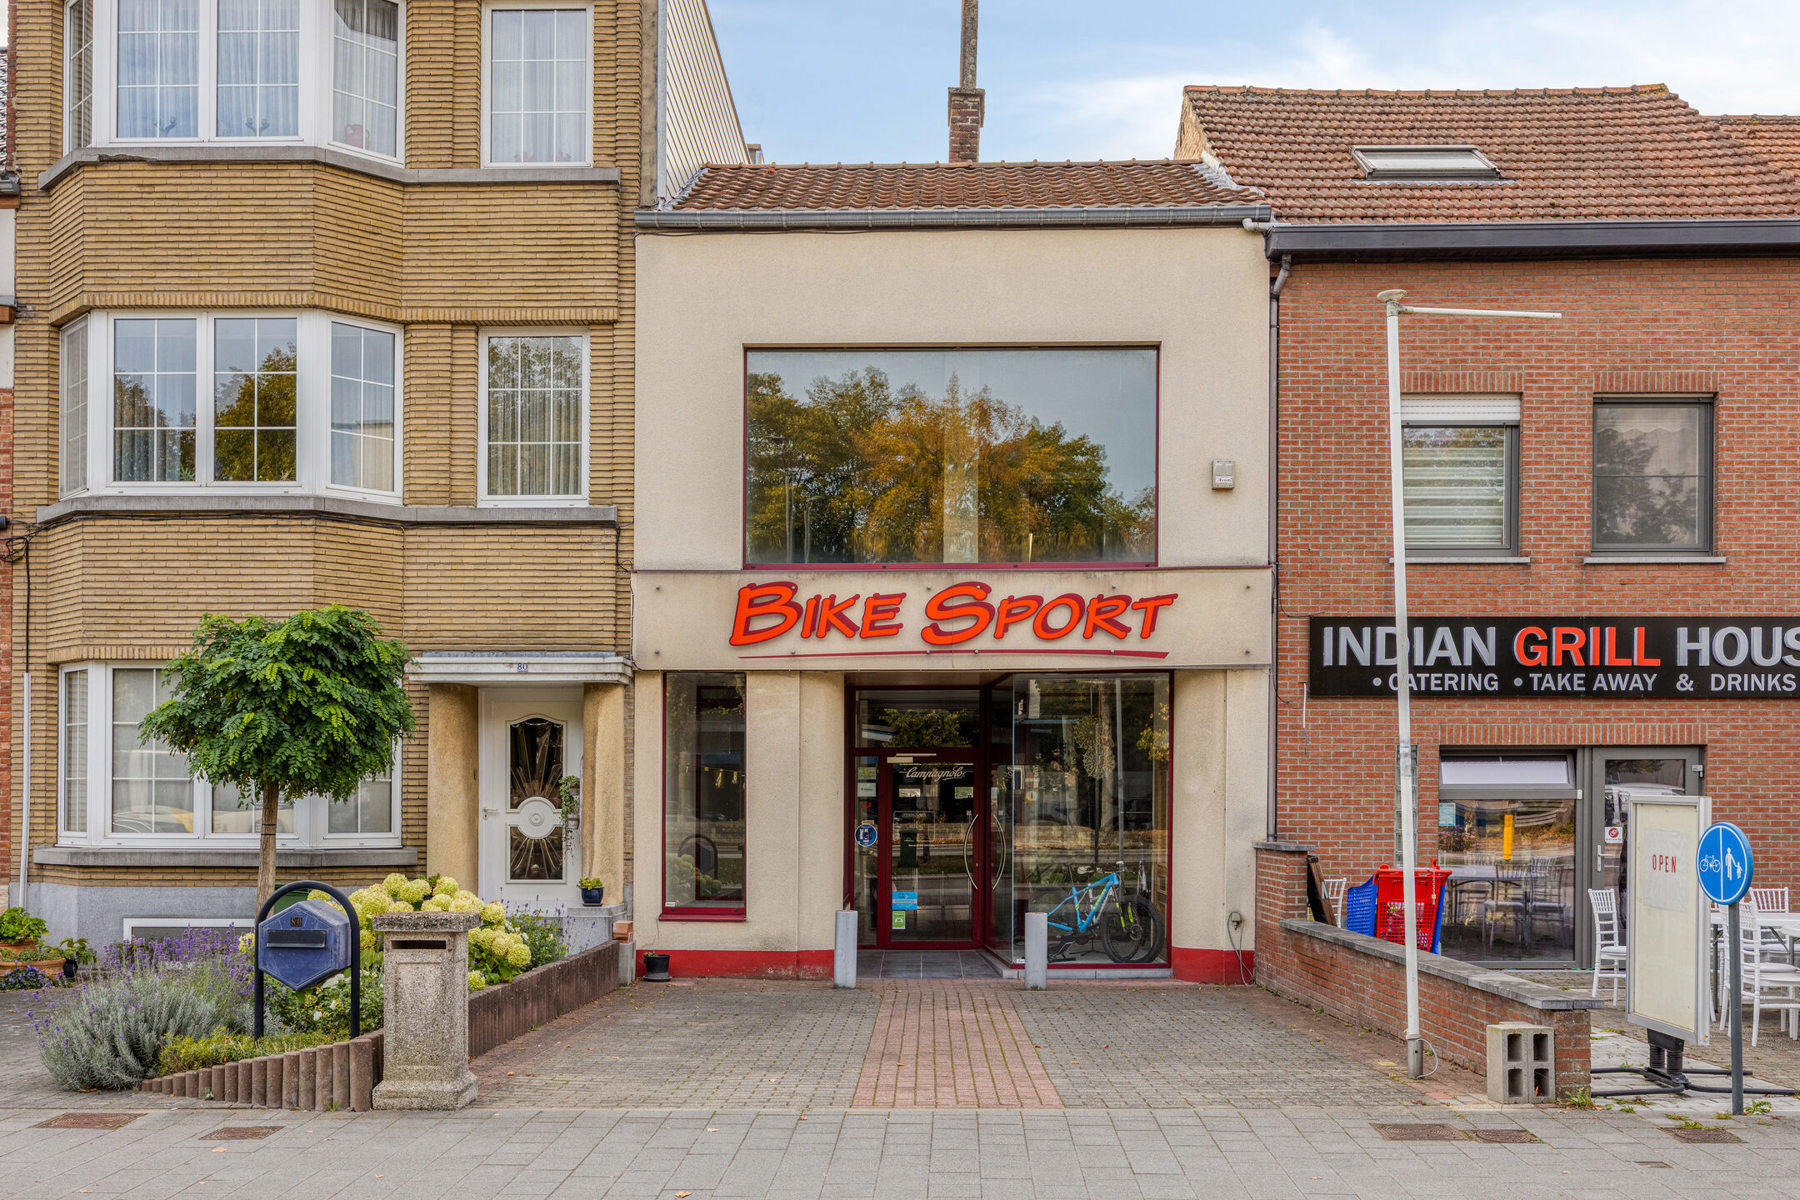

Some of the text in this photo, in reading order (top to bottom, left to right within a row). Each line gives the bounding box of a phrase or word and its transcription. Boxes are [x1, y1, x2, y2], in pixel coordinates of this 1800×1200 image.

[729, 581, 1178, 646] BIKE SPORT
[1323, 626, 1496, 666] INDIAN
[1513, 626, 1661, 666] GRILL
[1388, 673, 1797, 691] CATERING TAKE AWAY & DRINKS
[1652, 854, 1677, 873] OPEN
